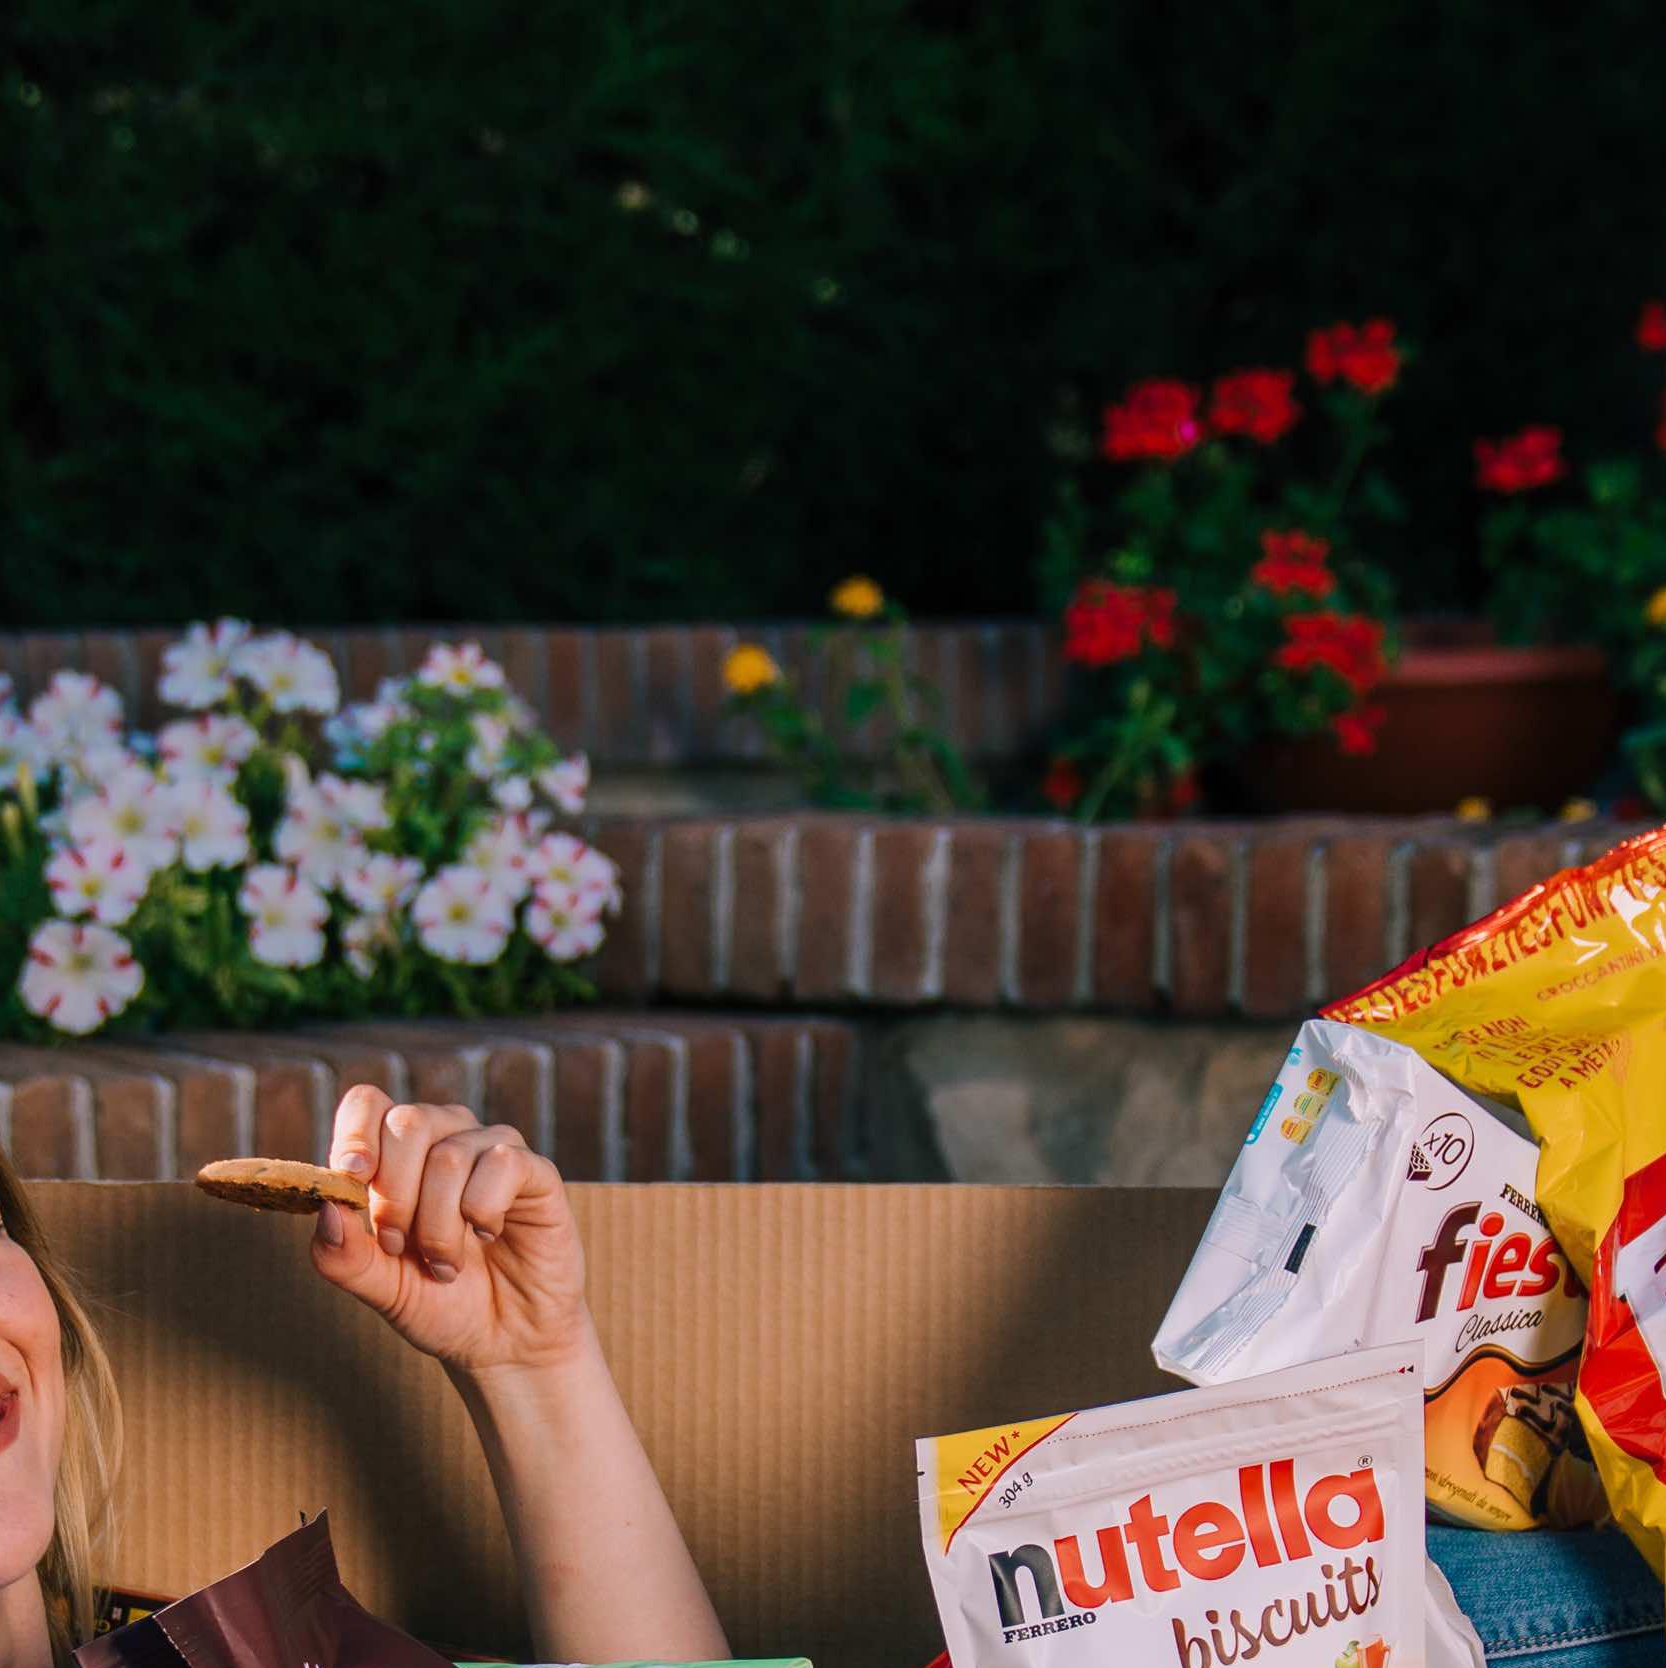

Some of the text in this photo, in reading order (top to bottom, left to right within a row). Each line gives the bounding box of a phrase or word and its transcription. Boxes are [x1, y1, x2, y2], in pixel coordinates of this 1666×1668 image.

[1423, 1132, 1466, 1167] x10
[1415, 1200, 1580, 1324] fies
[1455, 1308, 1546, 1353] Classica
[998, 1479, 1024, 1509] 304
[987, 1457, 1385, 1628] nutella
[1004, 1611, 1098, 1644] FERRERO
